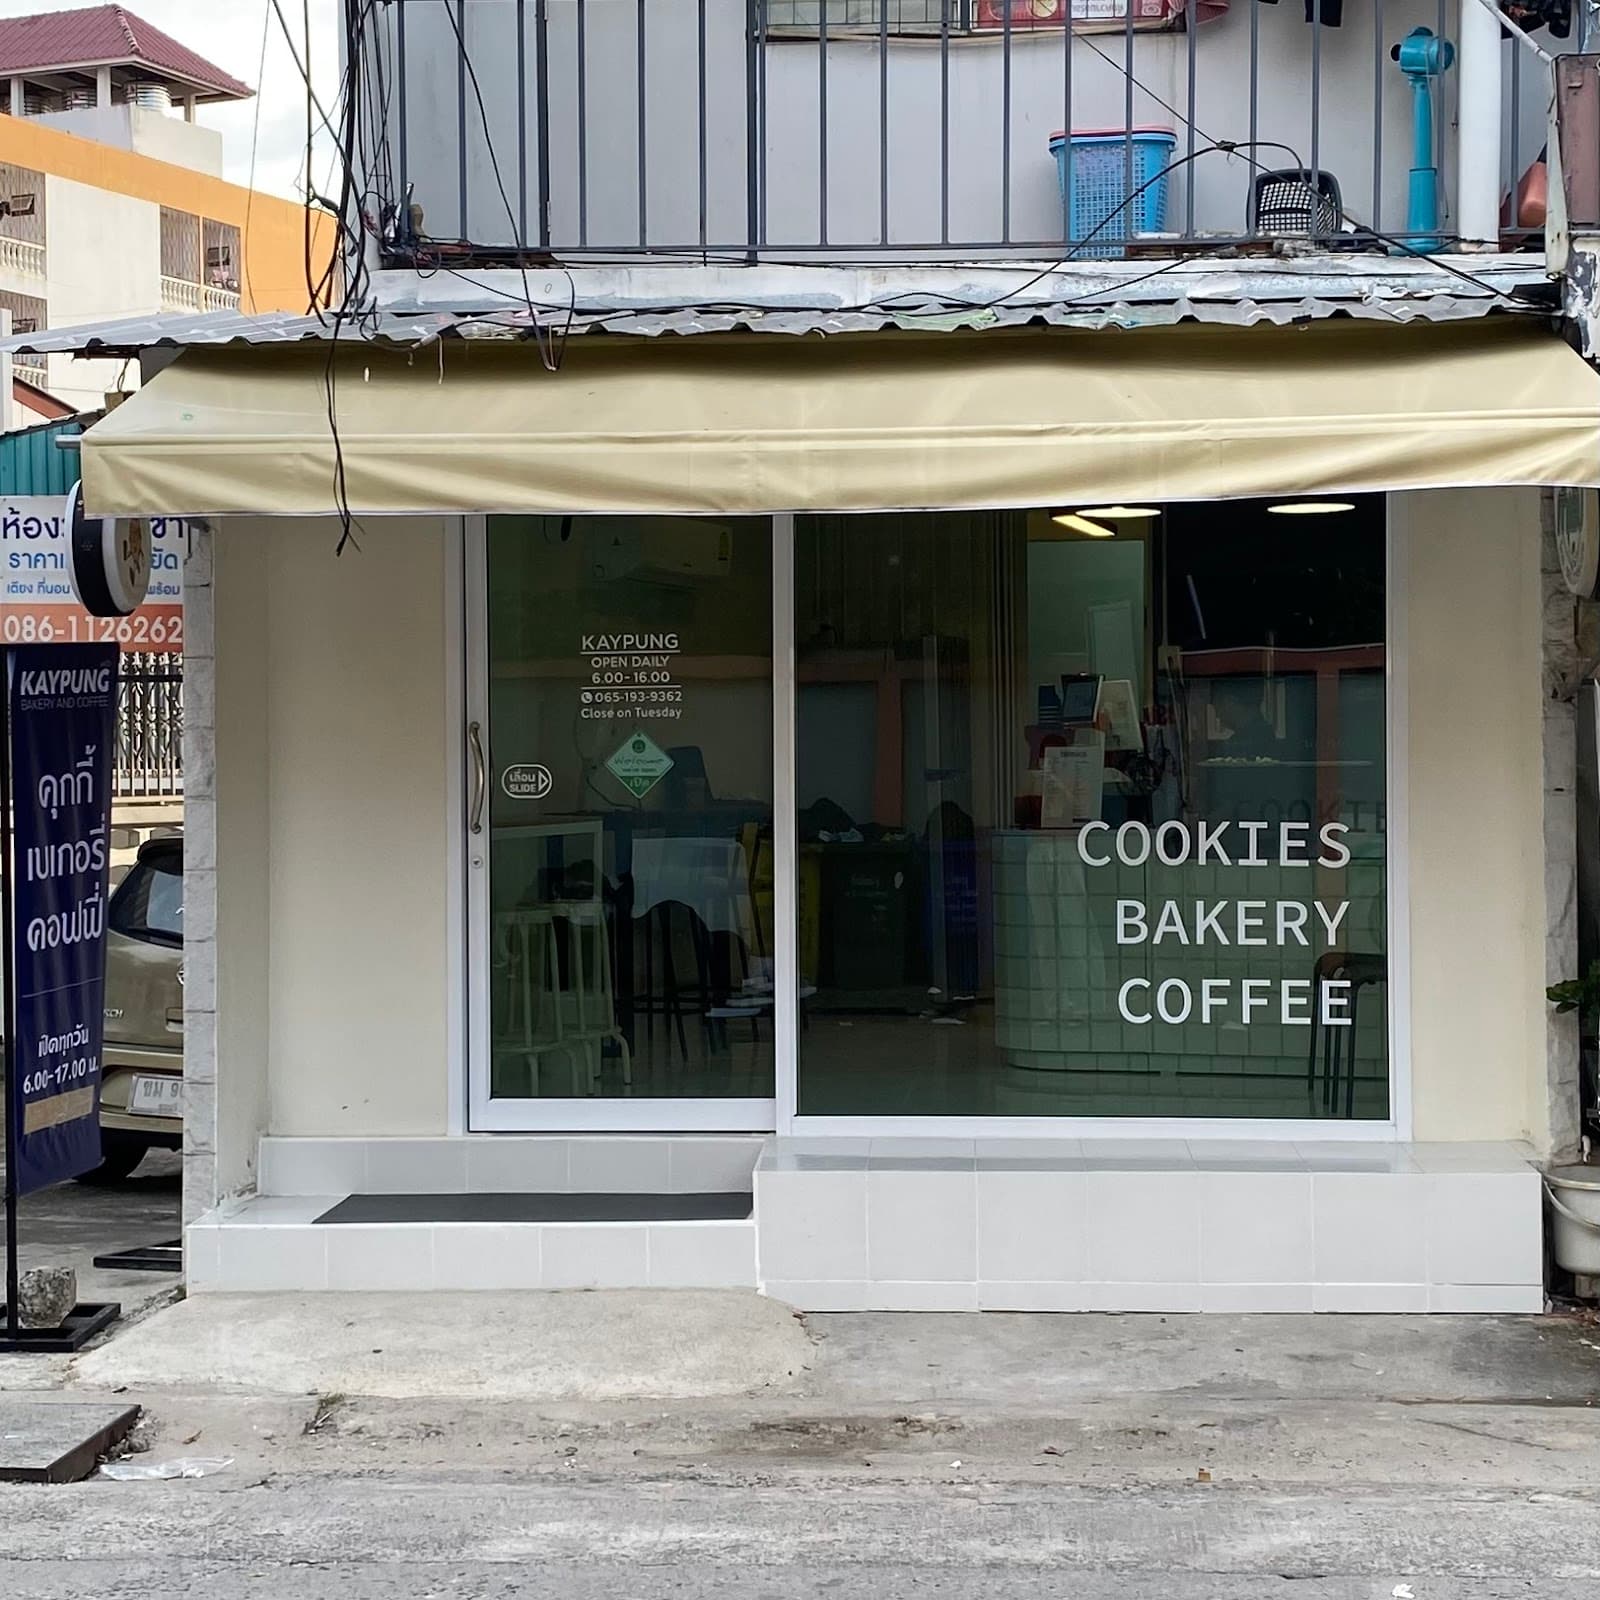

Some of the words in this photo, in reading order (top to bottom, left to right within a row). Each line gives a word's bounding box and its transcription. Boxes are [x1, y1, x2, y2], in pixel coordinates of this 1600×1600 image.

[3, 614, 183, 643] 086-1126262
[581, 633, 679, 650] KAYPUNG
[591, 656, 628, 668] OPEN
[631, 655, 670, 667] DAILY
[20, 668, 110, 696] KAYPUNG
[21, 698, 54, 711] BAKERY
[56, 696, 75, 709] AND
[76, 695, 109, 708] COFFEE
[594, 691, 682, 702] 065-193-9362
[580, 708, 614, 719] Close
[616, 709, 632, 718] on
[634, 707, 682, 720] Tuesday
[509, 783, 537, 793] SLIDE
[1077, 820, 1351, 868] COOKIES
[1116, 899, 1350, 945] BAKERY
[1118, 977, 1352, 1025] COFFEE
[23, 1060, 87, 1094] 6.00-17.00
